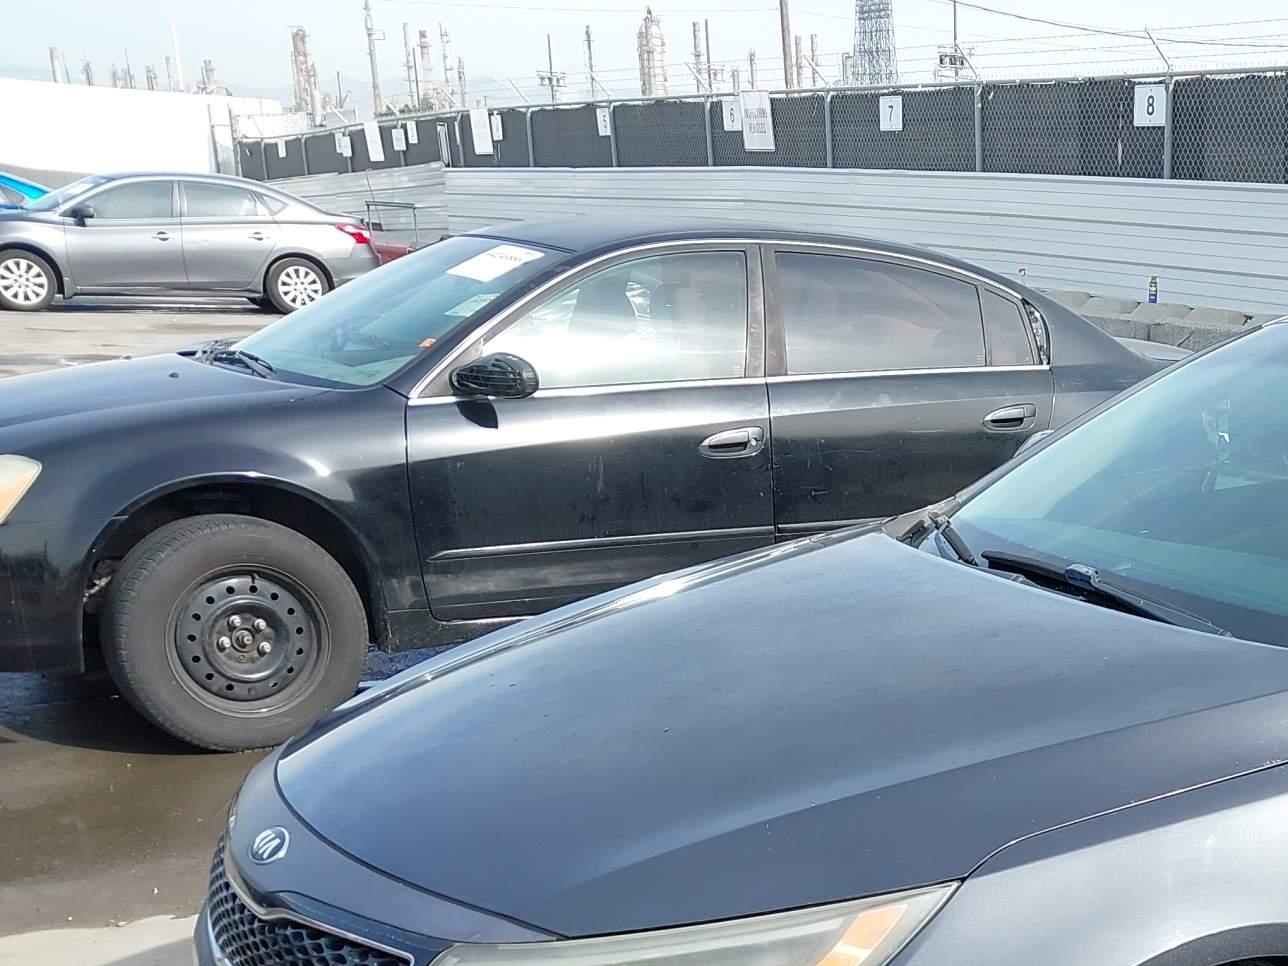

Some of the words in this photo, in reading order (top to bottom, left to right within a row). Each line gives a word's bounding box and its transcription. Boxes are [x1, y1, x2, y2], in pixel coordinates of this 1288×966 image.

[888, 105, 894, 122] 7
[1146, 95, 1155, 116] 8
[729, 107, 735, 123] 6
